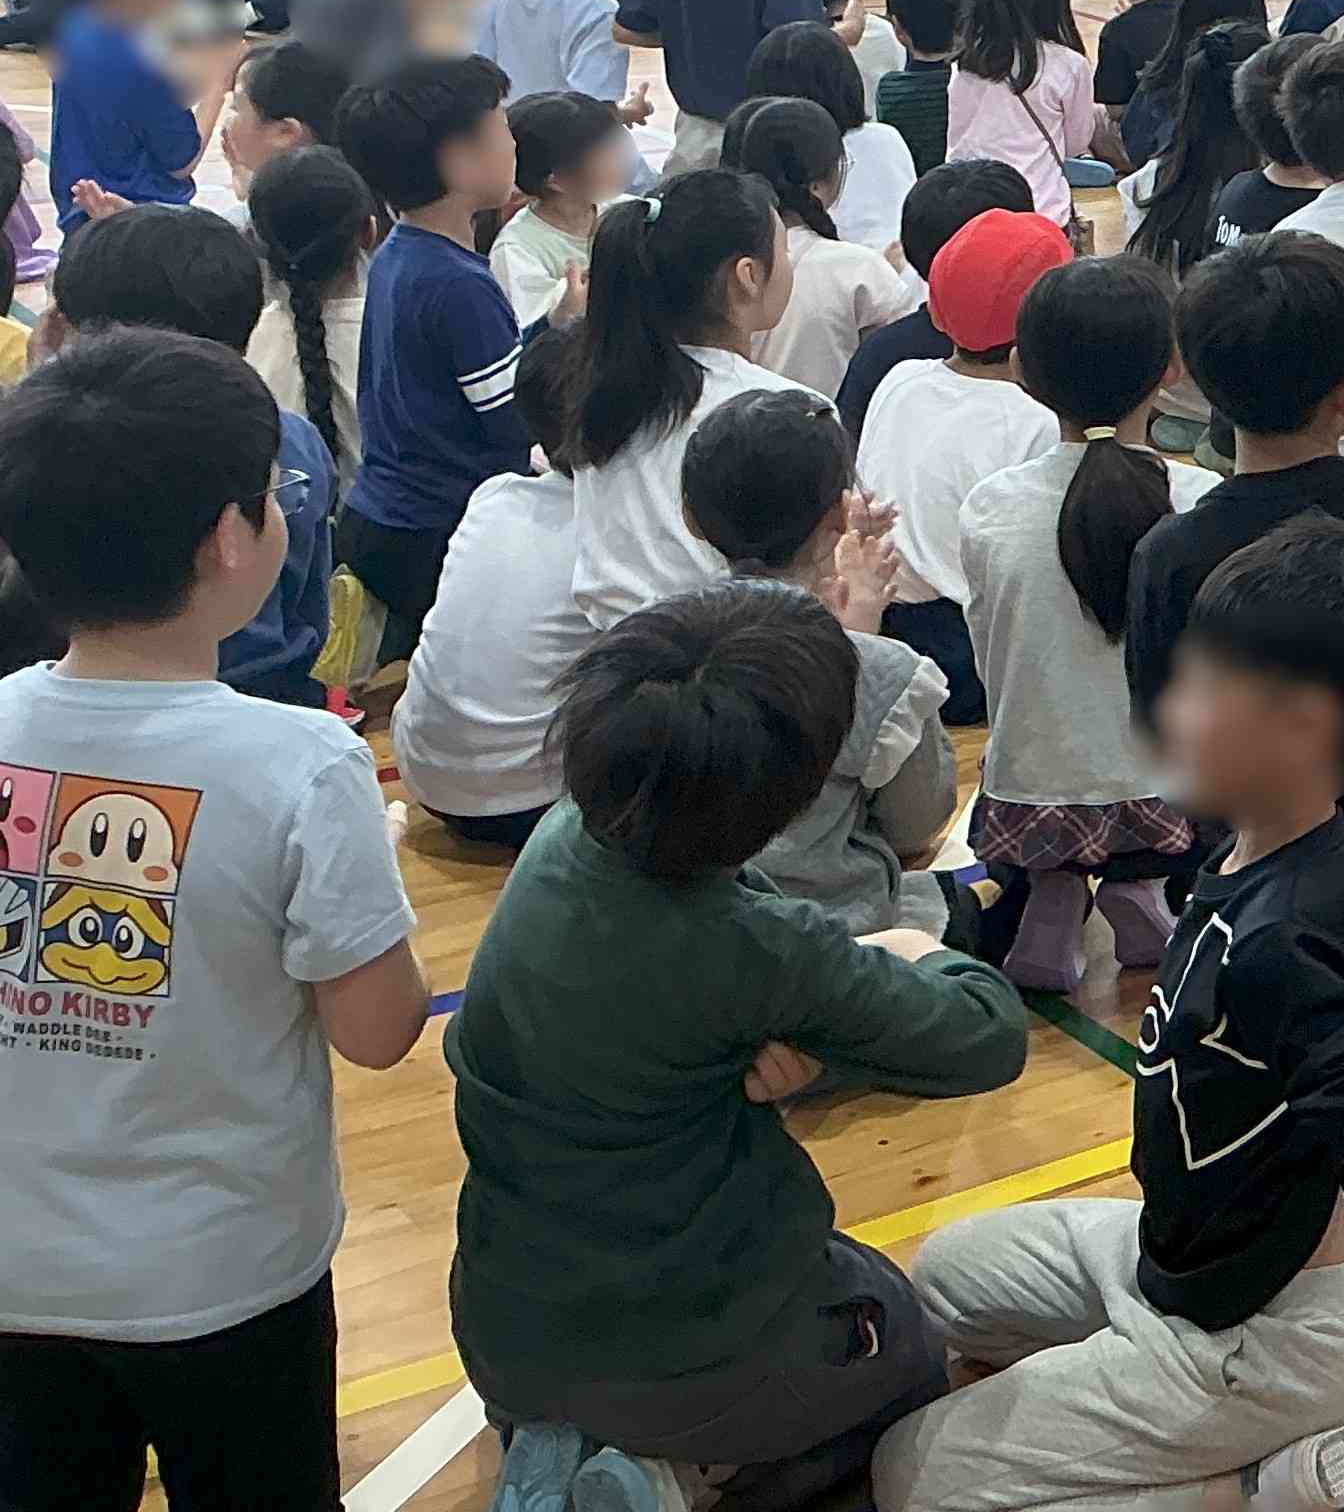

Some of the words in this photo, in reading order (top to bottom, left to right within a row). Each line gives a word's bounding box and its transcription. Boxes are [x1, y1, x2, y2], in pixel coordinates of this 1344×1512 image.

[61, 990, 155, 1029] KIRBY
[13, 1021, 82, 1037] WADDLE
[39, 1038, 82, 1052] KING
